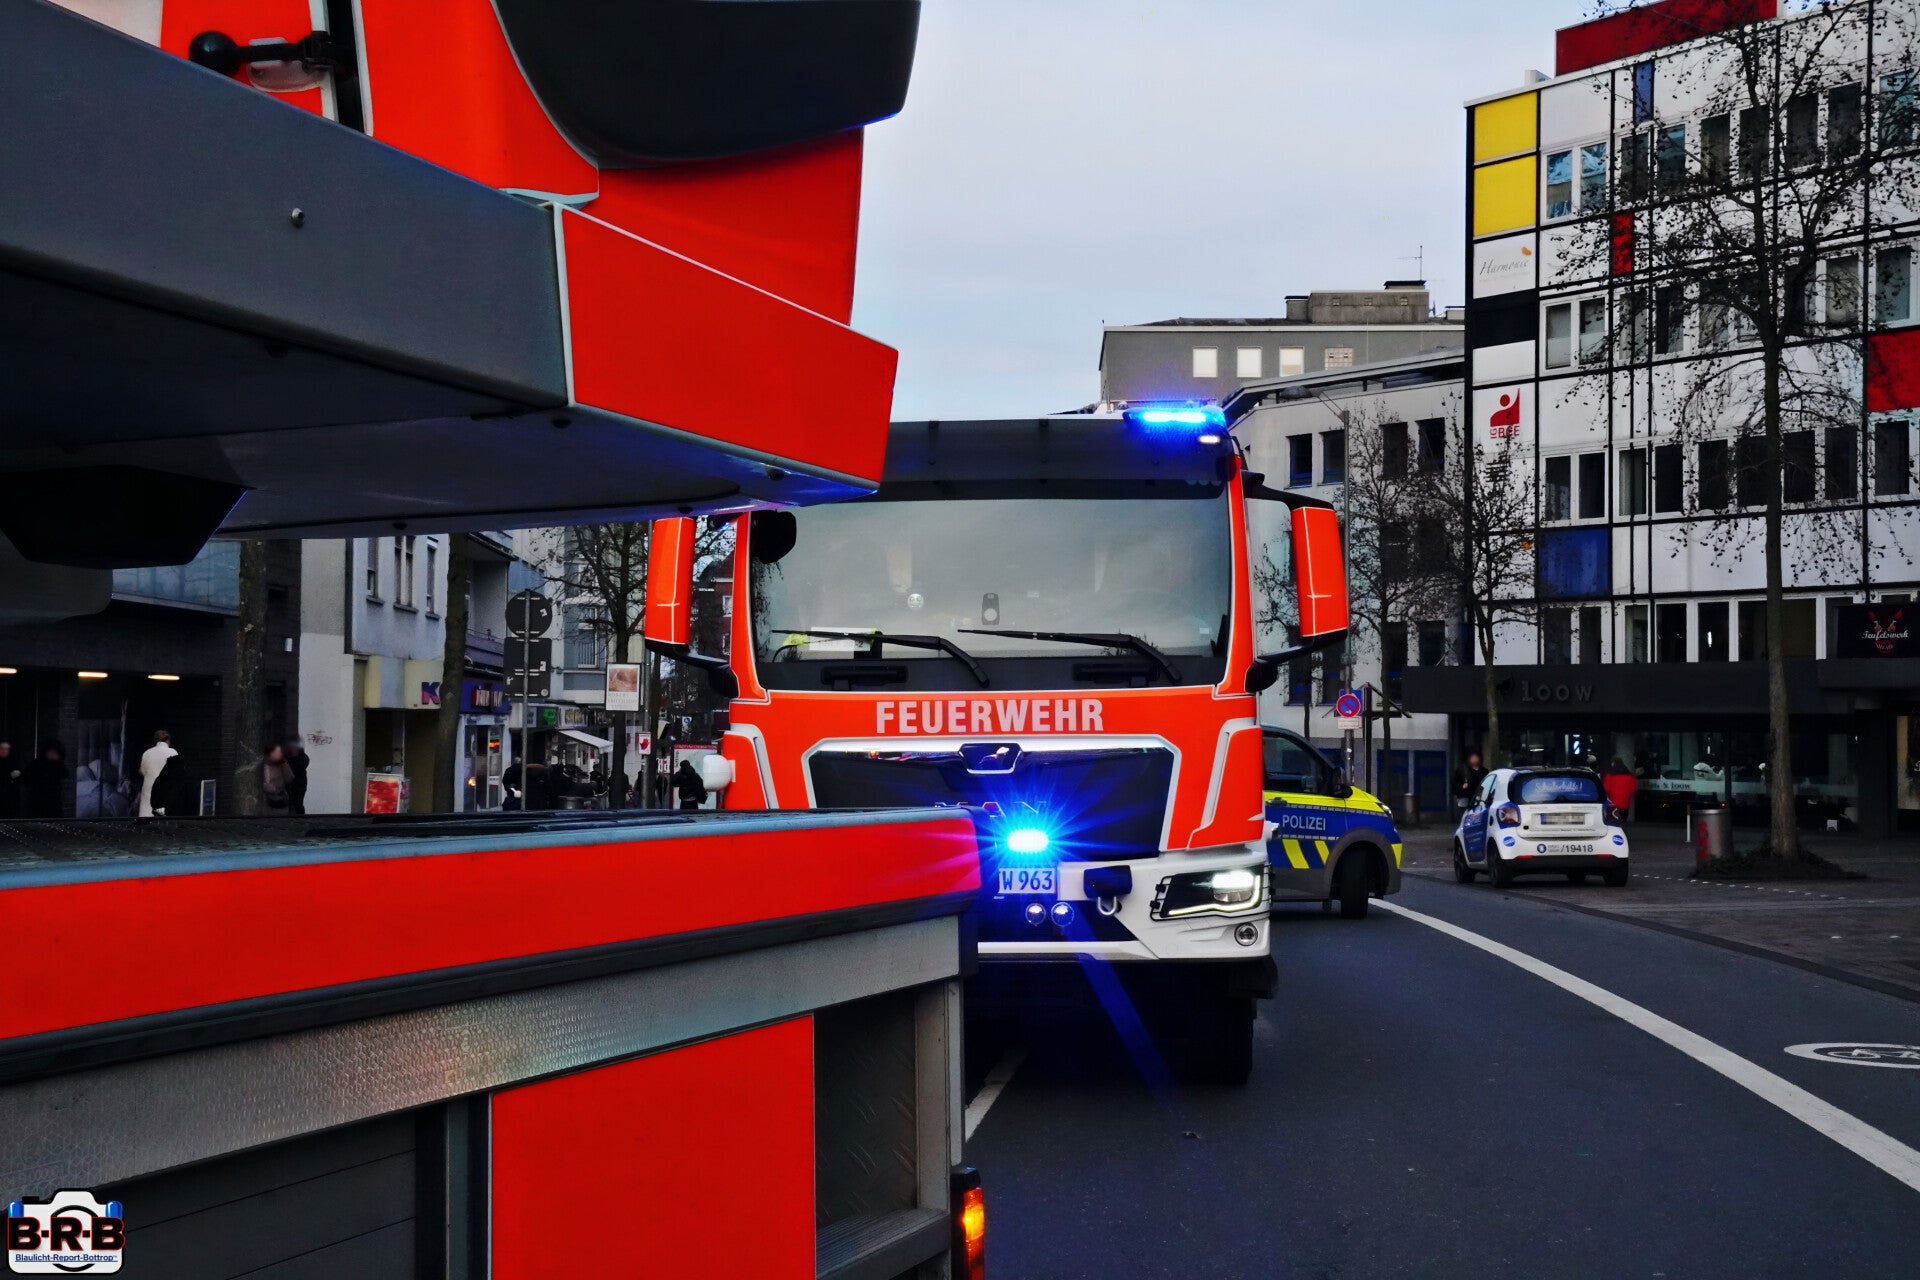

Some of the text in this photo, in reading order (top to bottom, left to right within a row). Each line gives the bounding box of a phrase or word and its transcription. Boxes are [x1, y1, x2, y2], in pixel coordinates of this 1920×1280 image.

[1521, 680, 1592, 702] loow
[875, 698, 1104, 734] FEUERWEHR
[1282, 814, 1326, 831] POLIZEI
[1018, 870, 1053, 891] 963
